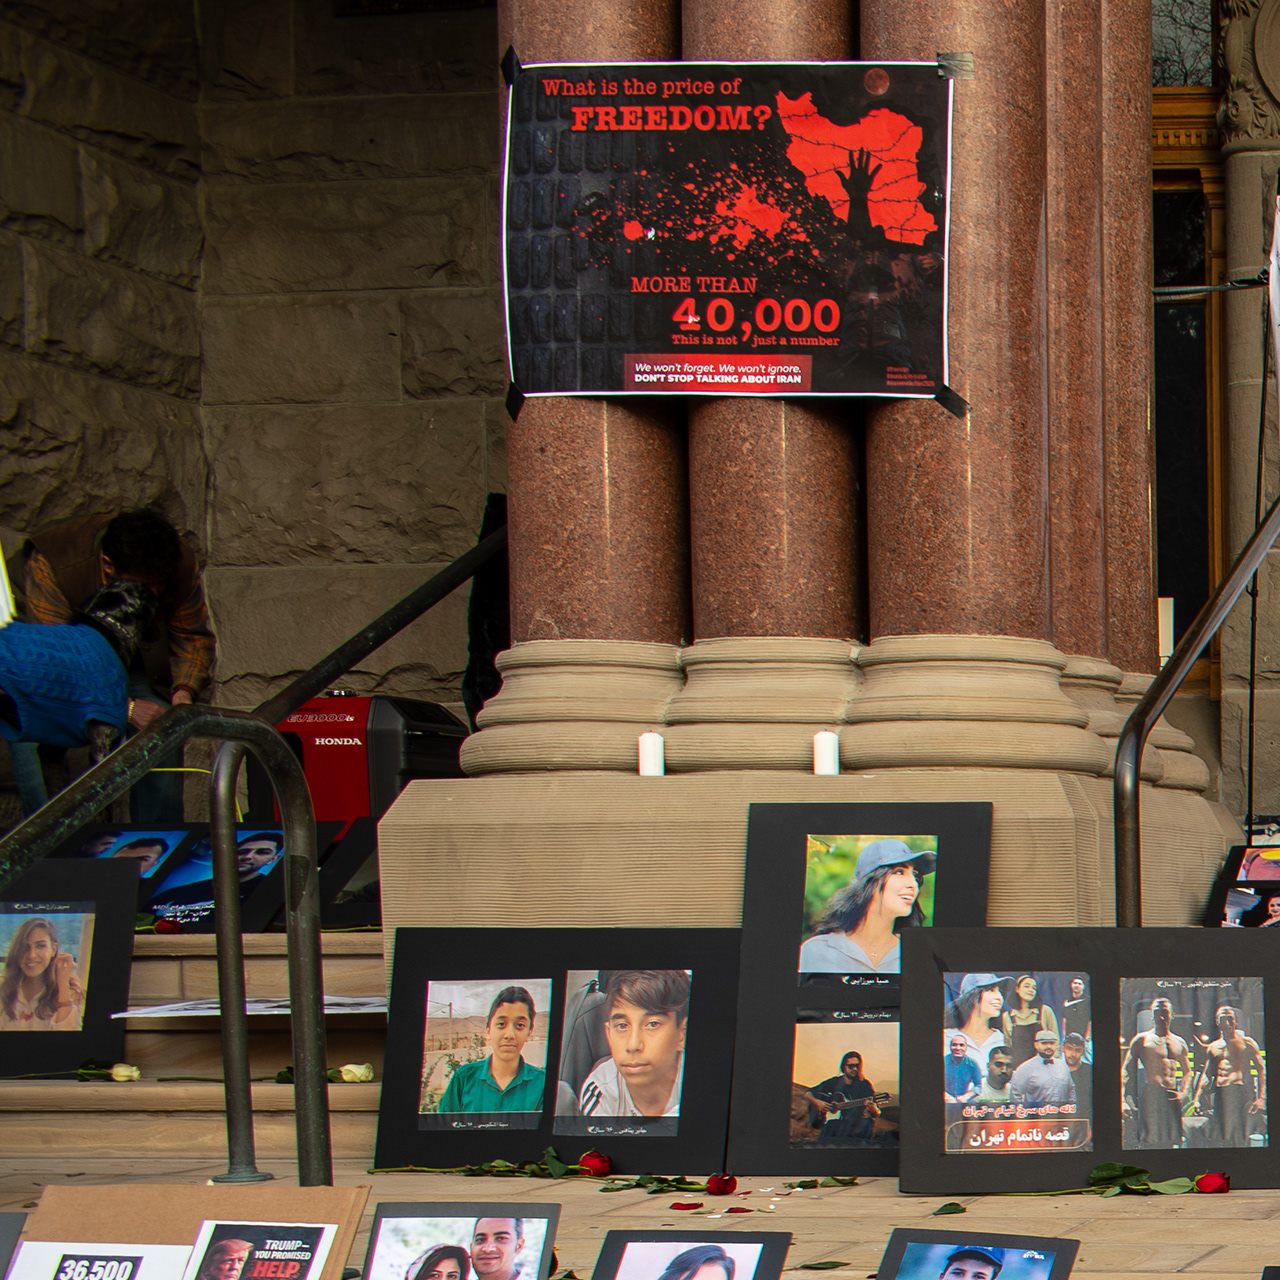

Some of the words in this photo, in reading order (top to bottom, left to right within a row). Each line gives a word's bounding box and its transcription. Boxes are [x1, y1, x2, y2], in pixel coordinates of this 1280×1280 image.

[542, 79, 596, 95] What
[601, 79, 617, 95] is
[624, 78, 656, 94] the
[662, 79, 714, 98] price
[720, 78, 742, 94] of
[571, 105, 771, 130] FREEDOM?
[631, 276, 690, 292] MORE
[697, 277, 757, 292] THAN
[673, 298, 840, 341] 40,000
[672, 334, 699, 344] This
[702, 334, 713, 344] is
[716, 336, 737, 344] not
[752, 335, 777, 347] just
[790, 336, 839, 345] number
[635, 363, 651, 373] We
[653, 363, 681, 373] won't
[684, 363, 715, 374] forget.
[719, 363, 735, 373] We
[737, 363, 766, 373] won't
[767, 363, 801, 374] ignore.
[635, 375, 665, 384] DON'T
[668, 375, 694, 384] STOP
[696, 375, 738, 384] TALKING
[741, 375, 775, 384] ABOUT
[777, 375, 802, 384] IRAN
[969, 1128, 1003, 1147] تهران
[1006, 1128, 1041, 1143] ناتمام
[1044, 1126, 1069, 1142] قصه
[254, 1250, 271, 1259] YOU
[272, 1251, 310, 1260] PROMISED
[253, 1261, 299, 1279] HELP
